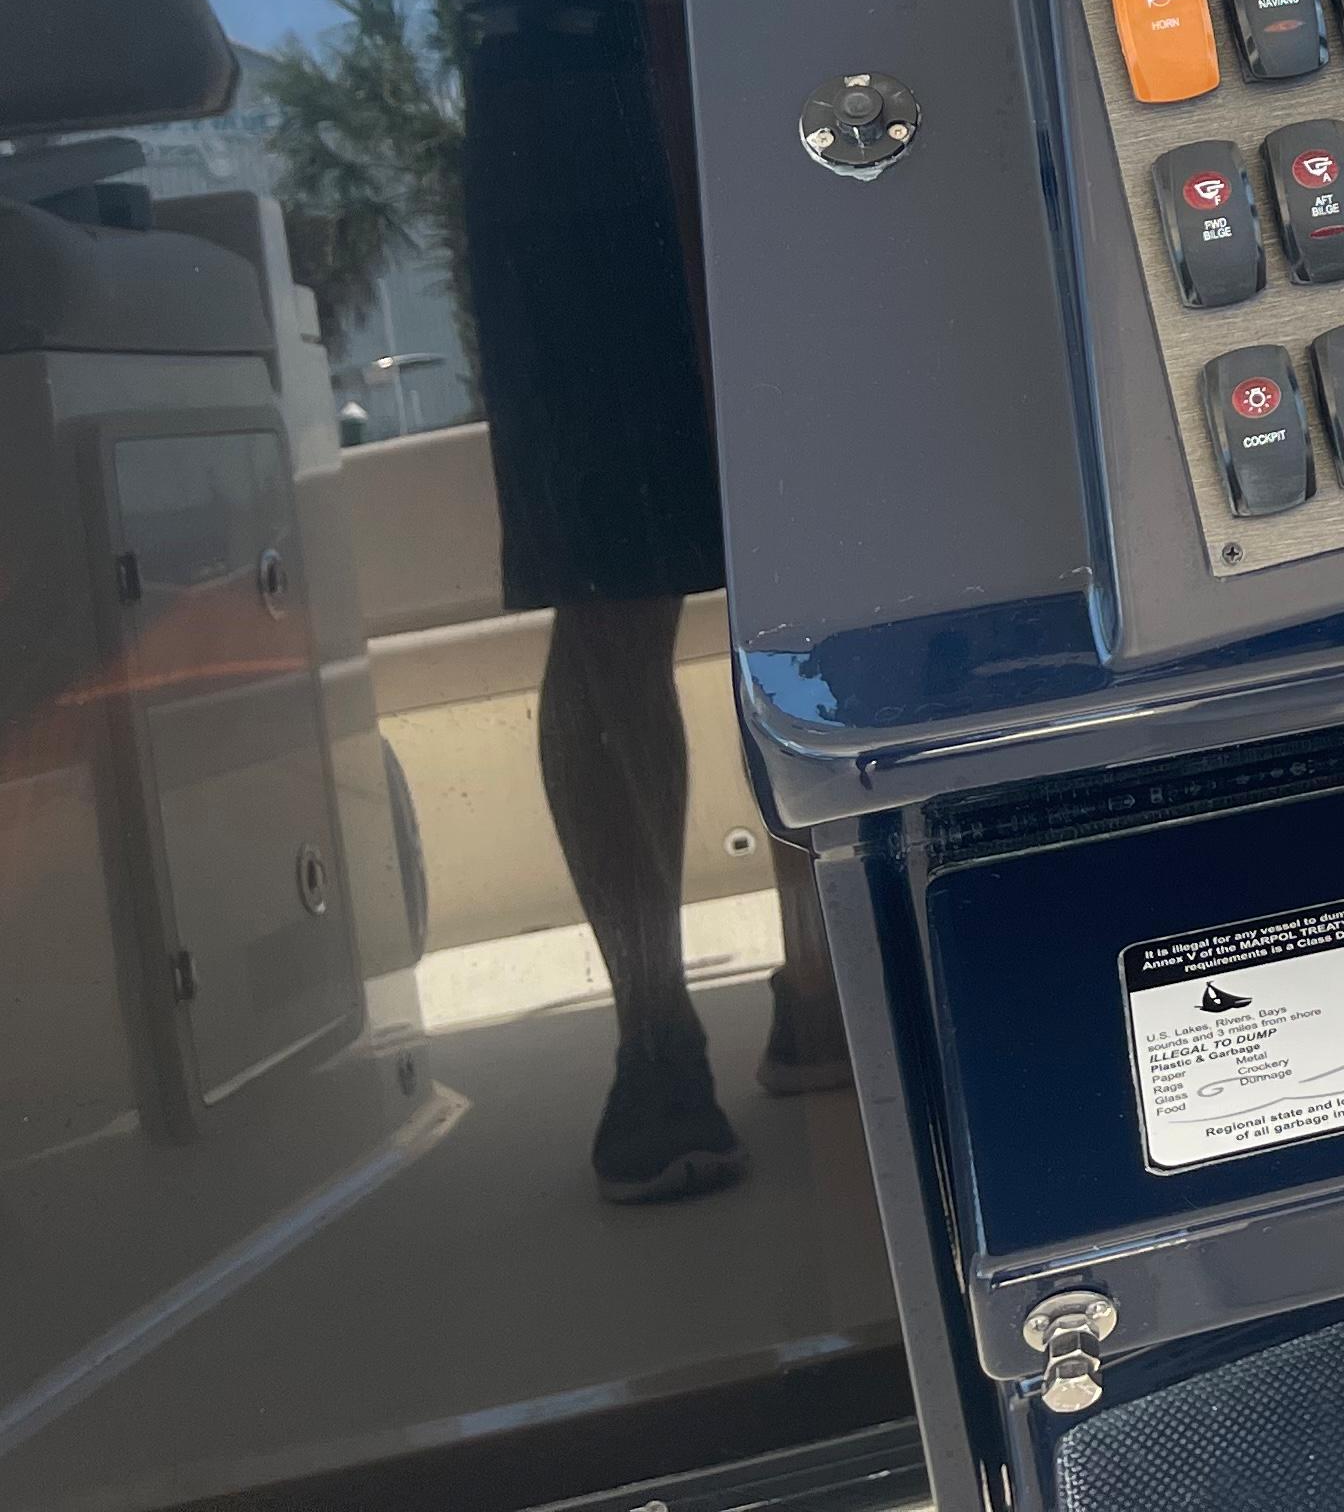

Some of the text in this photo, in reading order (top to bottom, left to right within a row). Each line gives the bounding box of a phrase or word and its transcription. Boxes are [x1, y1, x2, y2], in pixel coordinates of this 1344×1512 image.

[1151, 17, 1180, 30] HORN
[1315, 193, 1333, 207] AFT
[1311, 203, 1340, 217] BILGE
[1204, 218, 1227, 231] FWD
[1203, 227, 1232, 241] BILGE
[1242, 429, 1287, 449] COCKPIT
[1145, 950, 1154, 959] It
[1157, 948, 1168, 957] is
[1172, 938, 1210, 954] illegal
[1212, 933, 1231, 945] for
[1234, 929, 1257, 942] any
[1260, 919, 1301, 935] vessel
[1303, 917, 1316, 926] to
[1149, 1028, 1277, 1064] ILLEGAL TO DUMP
[1151, 1043, 1260, 1074] Plastic & Garbage
[1206, 1116, 1266, 1137] Regional
[1270, 1109, 1303, 1123] state
[1307, 1100, 1332, 1113] and
